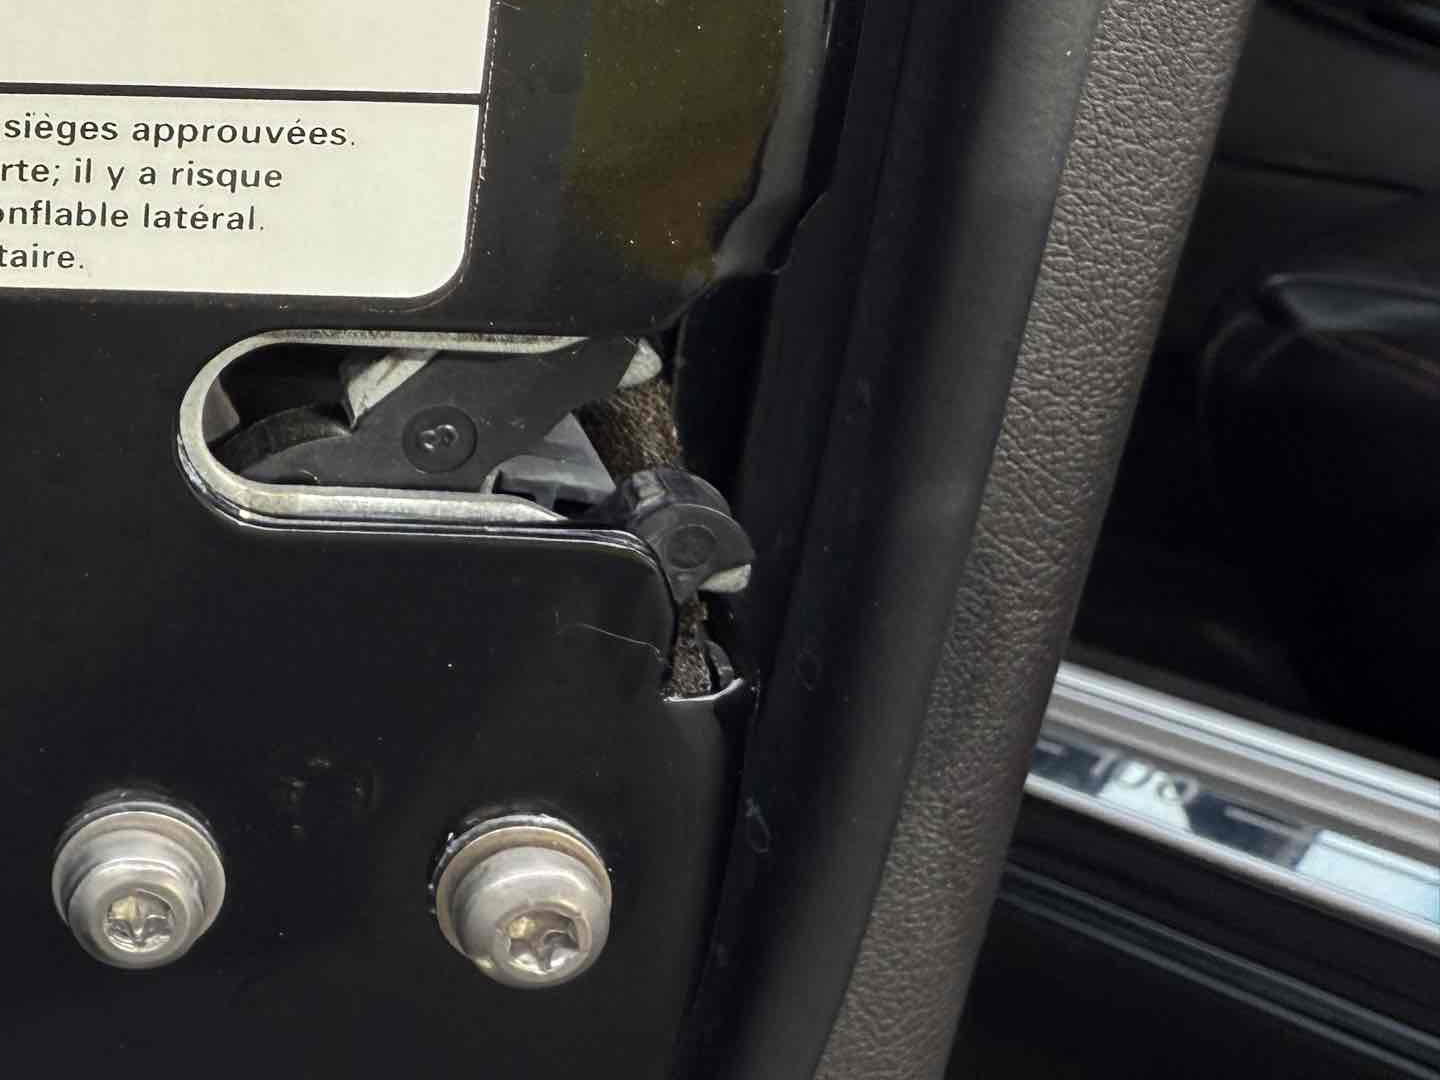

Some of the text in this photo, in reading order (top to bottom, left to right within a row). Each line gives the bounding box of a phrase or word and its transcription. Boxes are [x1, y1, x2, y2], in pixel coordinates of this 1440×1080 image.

[131, 119, 357, 150] approuvées.
[74, 157, 93, 185] il
[107, 165, 126, 191] y
[138, 164, 157, 186] a
[171, 160, 283, 194] risque
[143, 202, 266, 232] latéral.
